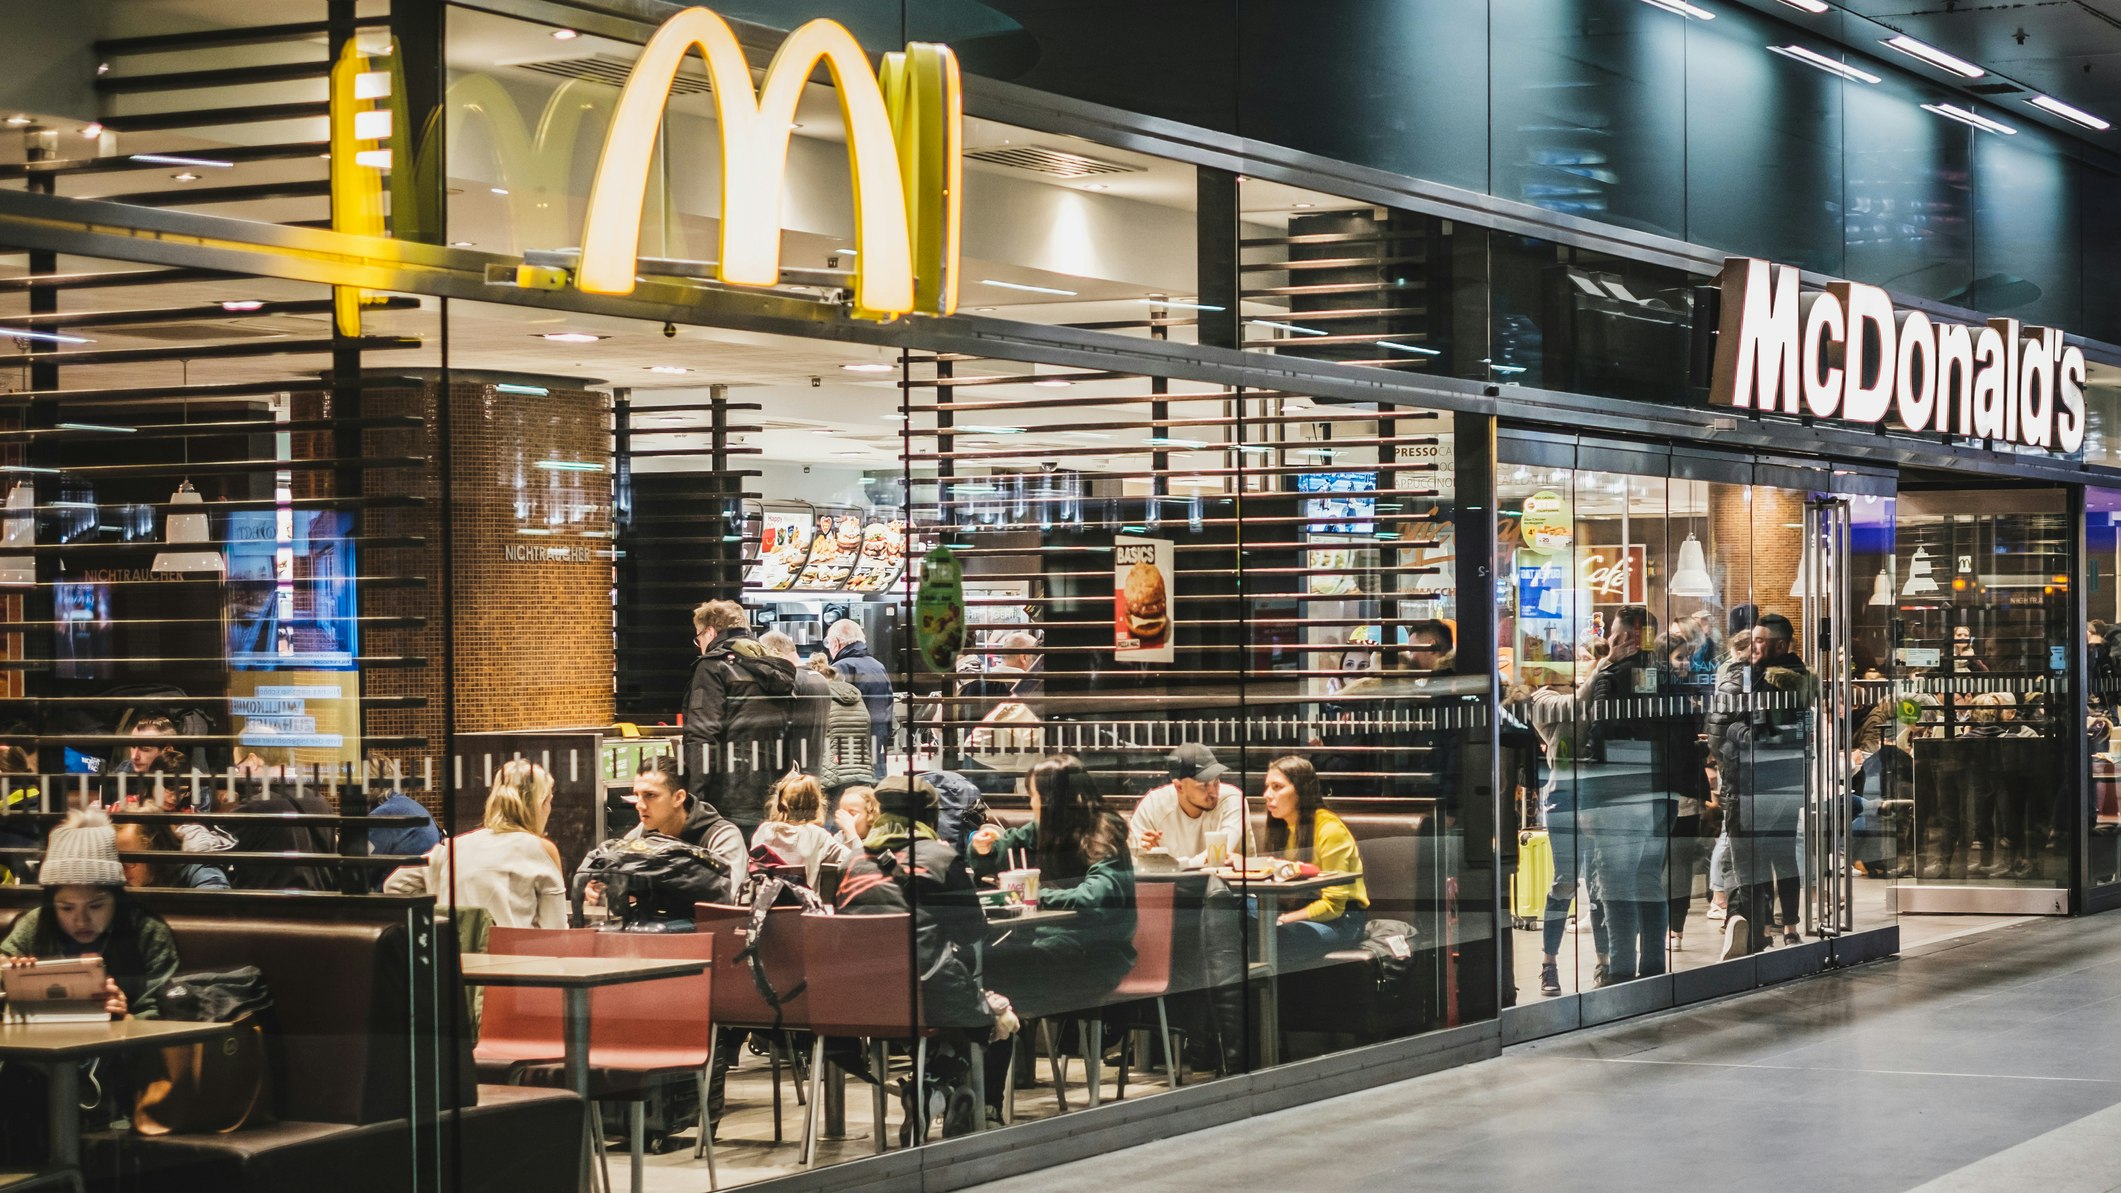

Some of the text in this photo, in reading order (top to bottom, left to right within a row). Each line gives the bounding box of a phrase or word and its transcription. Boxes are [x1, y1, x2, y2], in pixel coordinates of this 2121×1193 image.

[1731, 257, 2086, 453] McDonald's
[505, 545, 590, 562] NICHTRAUCHER
[1117, 547, 1155, 564] BASICS
[84, 568, 184, 582] NICHTRAUCHER
